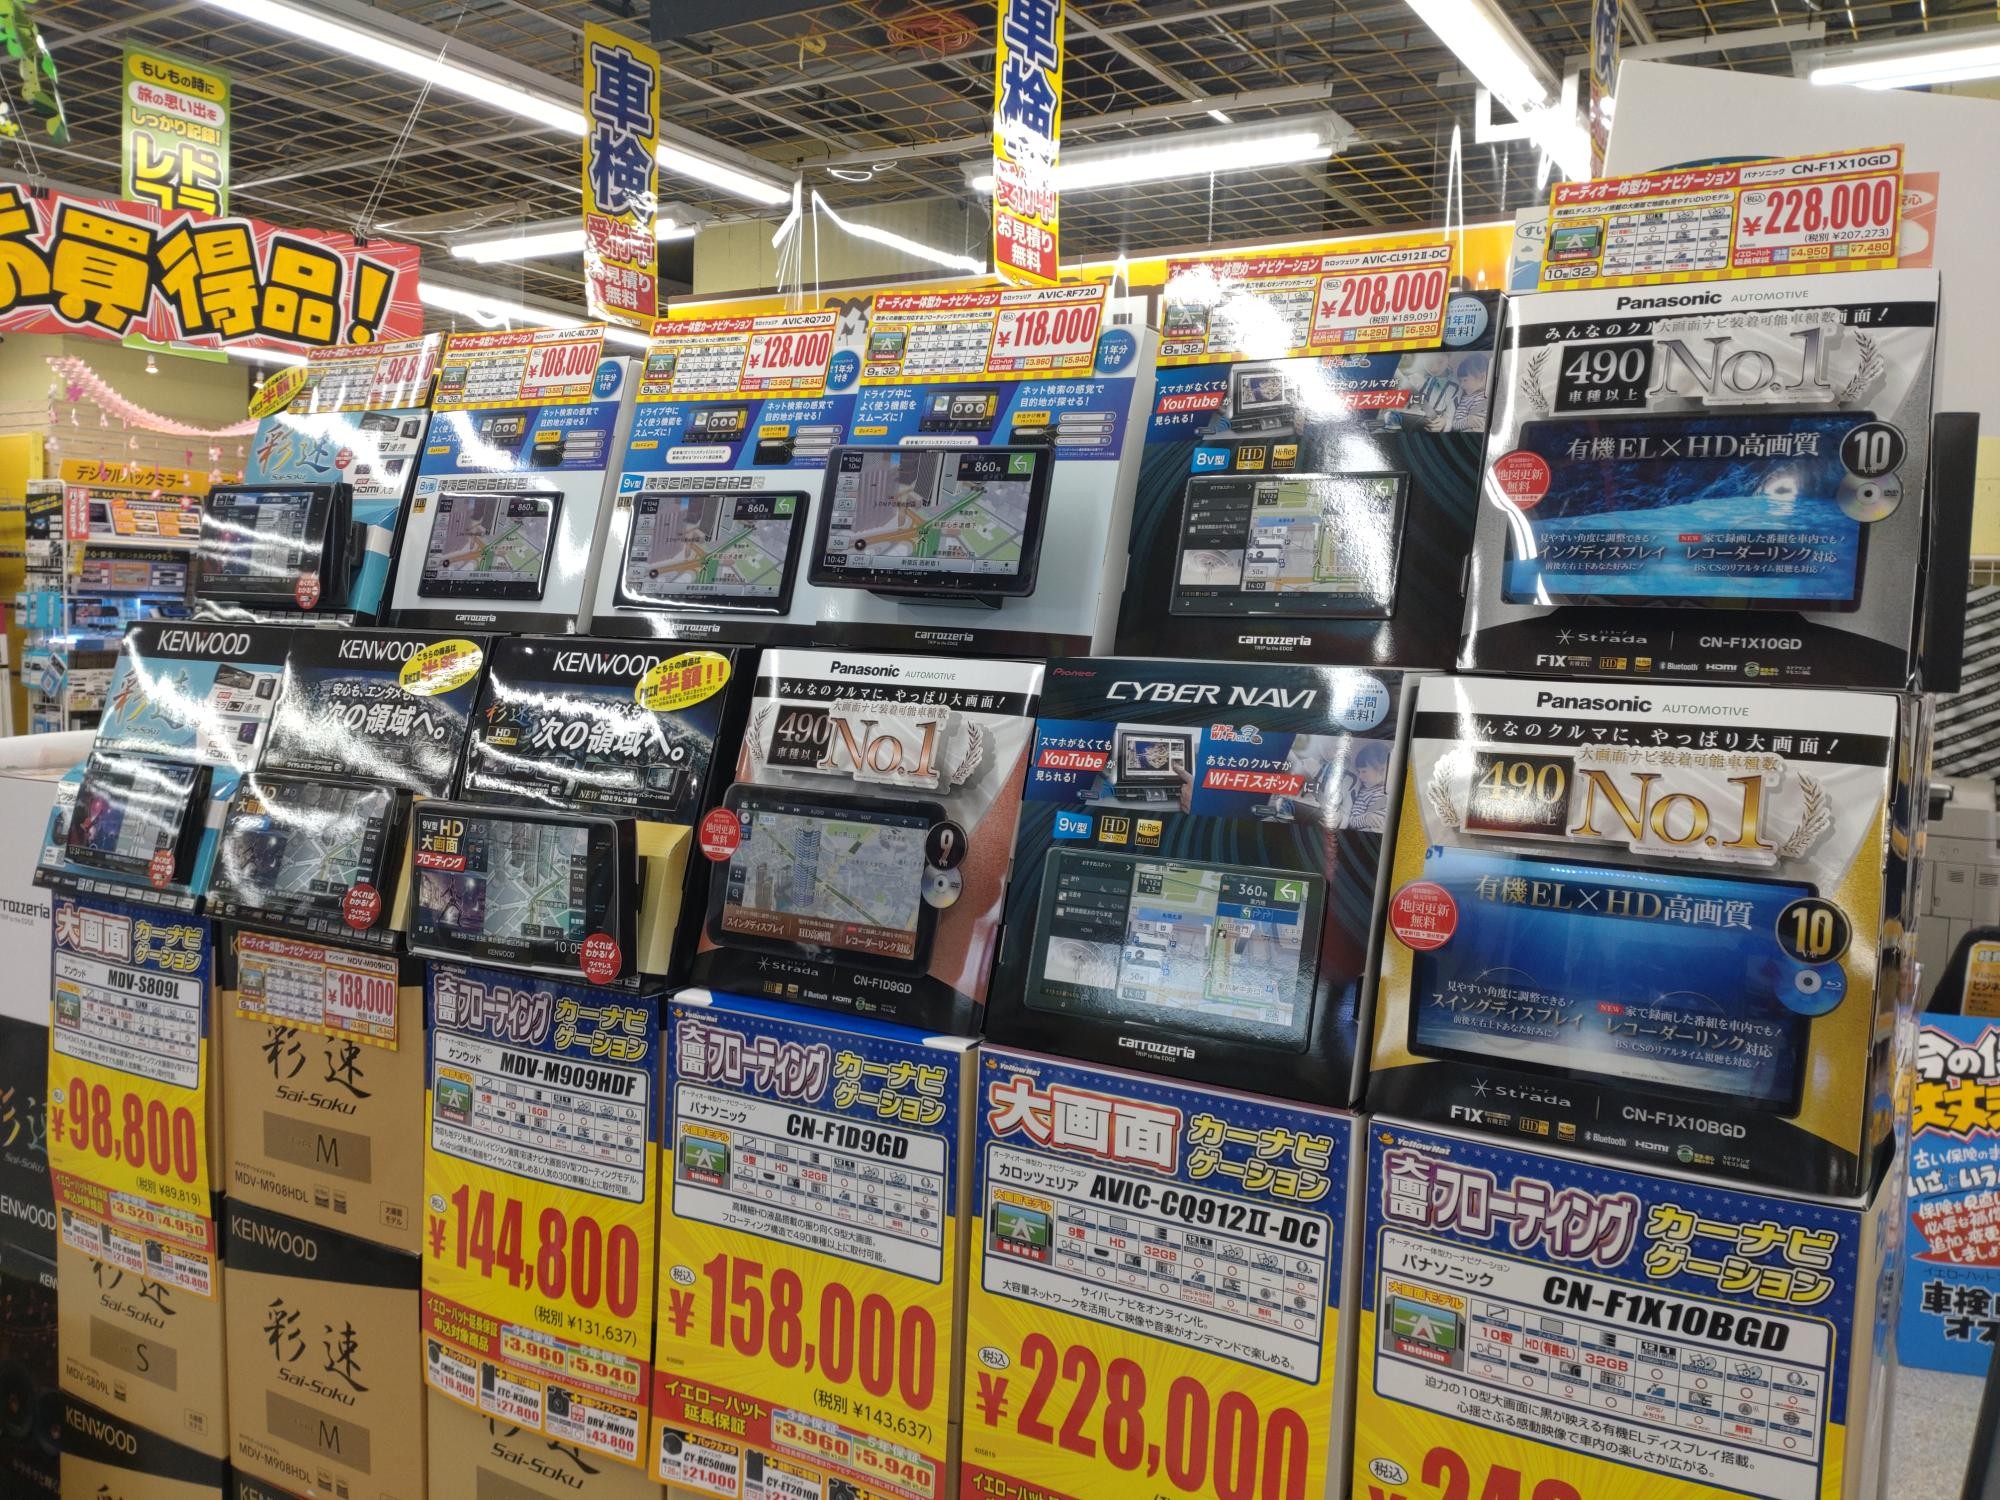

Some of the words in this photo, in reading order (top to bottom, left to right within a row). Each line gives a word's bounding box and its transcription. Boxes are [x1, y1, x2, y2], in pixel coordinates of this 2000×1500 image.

[140, 61, 215, 94] もしもの時に
[138, 86, 217, 121] 旅の思い出を
[131, 106, 222, 146] しっかり記録!
[589, 43, 655, 222] 車検
[1557, 170, 1737, 201] オーディオ一体型カーナビゲーション
[1792, 154, 1892, 175] CN-F1X10GD
[1741, 179, 1892, 237] ¥228,000
[997, 215, 1055, 253] お見積り
[1804, 232, 1829, 244] (税別
[1832, 227, 1889, 242] ¥207,273)
[1011, 243, 1042, 272] 無料
[876, 293, 999, 310] オーディオ一体型カーナビゲーション
[1037, 287, 1097, 300] AVIC-RF720
[1320, 269, 1445, 320] ¥208,000
[1616, 290, 1723, 311] Panasonic
[1730, 289, 1810, 304] AUTOMOTIVE
[558, 328, 600, 340] AVIC-RL720
[782, 315, 832, 327] AVIC-RQ720
[997, 306, 1097, 348] ¥118,000
[528, 350, 598, 380] ¥108,000
[748, 332, 828, 370] ¥128,000
[1565, 346, 1645, 385] 490
[1648, 327, 1836, 396] No.1
[863, 388, 913, 399] ドライブ中に
[1020, 396, 1090, 408] 目的地が探せる!
[1022, 385, 1105, 396] ネット検索の感覚で
[1159, 381, 1229, 395] スマホがなくても
[1162, 394, 1220, 411] YouTube
[542, 407, 600, 418] ネット検索の感覚で
[639, 407, 679, 417] ドライブ中に
[767, 400, 834, 410] ネット検索の感覚で
[857, 410, 904, 423] スムーズに!
[859, 400, 917, 411] よく使う機能を
[1155, 412, 1195, 427] 見られる!
[633, 426, 672, 438] スムーズに!
[1238, 446, 1264, 461] HD
[1853, 430, 1889, 469] 10
[1685, 543, 1838, 564] レコーダーリンク対応
[157, 629, 251, 655] KENWOOD
[914, 629, 975, 642] carrozzeria
[1238, 634, 1312, 647] carrozzeria
[1577, 632, 1648, 645] Strada
[1699, 635, 1803, 651] CN-F1X10GD
[654, 655, 702, 675] こちらの商品は
[829, 660, 901, 679] Panasonic
[904, 670, 958, 682] AUTOMOTIVE
[1052, 667, 1098, 678] Pioneer
[1536, 653, 1567, 668] F1X
[1666, 662, 1700, 672] Bluetooth
[779, 681, 1008, 711] みんなのクルマに、やっぱり大画面!
[1105, 680, 1221, 706] CYBER
[1226, 686, 1319, 710] NAVI
[1536, 691, 1653, 714] Panasonic
[1661, 703, 1751, 718] AUTOMOTIVE
[494, 726, 511, 738] HD
[777, 710, 829, 744] 490
[1472, 720, 1840, 757] んなのクルマに、やっぱり大画面!
[819, 718, 941, 778] No.1
[1039, 736, 1113, 752] スマホがなくても
[1042, 750, 1104, 769] YouTube
[1034, 769, 1077, 784] 見られる!
[1205, 755, 1293, 771] あなたのクルマが
[1477, 760, 1567, 804] 490
[1102, 817, 1128, 834] HD
[1569, 768, 1775, 852] No.1
[439, 817, 464, 837] HD
[1137, 836, 1159, 846] AUDIO
[1138, 822, 1162, 834] Hi-Res
[420, 834, 459, 854] 大画面
[415, 852, 464, 871] フローティング
[1399, 898, 1451, 918] 地図更新
[1473, 873, 1755, 931] 有機EL×HD高画質
[56, 904, 132, 962] 大画面
[135, 920, 204, 950] カーナビ
[1410, 913, 1437, 930] 無料
[1791, 906, 1834, 953] 10
[135, 942, 201, 972] ゲーション
[586, 939, 614, 951] めくれば
[107, 969, 180, 1000] MDV-S809L
[772, 961, 819, 977] Strada
[853, 974, 913, 995] CN-F1D9GD
[1446, 979, 1575, 1009] 見やすい角度に調整できる!
[328, 972, 395, 1018] ¥138,000
[1431, 991, 1585, 1028] スイングディスプレイ
[457, 984, 550, 1043] フローティング
[555, 998, 648, 1034] カーナビ
[1624, 1004, 1783, 1038] 家で録画した番組を車内でも!
[555, 1025, 647, 1061] ゲーション
[1117, 1035, 1197, 1060] carrozzeria
[1606, 1016, 1775, 1060] レコーダーリンク対応
[447, 1048, 482, 1066] ケンウッド
[708, 1032, 829, 1102] フローティング
[835, 1052, 946, 1095] カーナビ
[998, 1060, 1042, 1078] YellowHat
[500, 1052, 638, 1097] MDV-M909HDF
[275, 1084, 360, 1117] Sai-Soku
[689, 1100, 748, 1124] パナソニック
[835, 1081, 945, 1124] ゲーション
[1494, 1085, 1573, 1109] Strada
[1621, 1105, 1748, 1141] CN-F1X10BGD
[51, 1076, 199, 1185] ¥98,800
[785, 1112, 910, 1162] CN-F1D9GD
[990, 1077, 1179, 1169] 大画面
[1450, 1104, 1484, 1123] F1X
[1592, 1131, 1628, 1148] Bluetooth
[316, 1133, 340, 1168] M
[1190, 1114, 1333, 1167] カーナビ
[1396, 1136, 1451, 1157] YellowHat
[774, 1162, 789, 1174] HD
[800, 1168, 829, 1184] 32GB
[998, 1161, 1080, 1192] カロッツェリア
[1189, 1147, 1331, 1201] ゲーション
[159, 1183, 202, 1208] ¥89,819)
[234, 1169, 310, 1204] MDV-M908HDL
[992, 1188, 1053, 1213] 大画面モデル
[1389, 1155, 1432, 1222] 大画面
[730, 1201, 878, 1248] 高精細HD液晶搭載の振り向く9型大画面。
[1432, 1165, 1634, 1264] フローティング
[230, 1213, 319, 1263] KENWOOD
[721, 1211, 889, 1264] フローティング構造で490車種以上に取付可能。
[1067, 1226, 1086, 1241] 9型
[1109, 1236, 1127, 1250] HD
[1646, 1203, 1838, 1268] カーナビ
[428, 1182, 640, 1320] ¥144,800
[1143, 1245, 1178, 1264] 32GB
[1387, 1236, 1511, 1273] オーディオ一体型カーナビゲーション
[671, 1268, 693, 1283] 税込
[1400, 1253, 1496, 1289] パナソニック
[1646, 1242, 1834, 1305] ゲーション
[1079, 1285, 1211, 1332] サイバーナビをオンライン化。
[1387, 1280, 1467, 1311] 大画面モデル
[99, 1293, 166, 1332] Sai-Soku
[533, 1304, 564, 1329] (税別
[566, 1313, 638, 1348] ¥131,637)
[1001, 1278, 1298, 1373] 大容量ネットワークを活用して映像や音楽がオンデマンドで楽しめる。
[1542, 1275, 1791, 1354] CN-F1X10BGD
[263, 1296, 370, 1393] 彩速
[433, 1316, 490, 1352] 申込対象商品
[667, 1251, 937, 1412] ¥158,000
[1481, 1326, 1514, 1347] 10型
[135, 1343, 150, 1373] S
[981, 1348, 1008, 1367] 税込
[1584, 1351, 1630, 1373] 32GB
[276, 1366, 356, 1408] Sai-Soku
[665, 1380, 768, 1421] イエローハット
[64, 1404, 138, 1456] KENWOOD
[683, 1402, 747, 1437] 延長保証
[813, 1387, 848, 1416] (税別
[852, 1401, 934, 1446] ¥143,637)
[975, 1330, 1311, 1500] ¥228,000
[1424, 1374, 1758, 1473] 迫力の10型大画面に黒が映える有機ELディスプレイ搭載。
[317, 1419, 342, 1455] M
[1455, 1401, 1718, 1480] 心揺さぶる感動映像で車内の楽しさが広がる。
[238, 1440, 313, 1485] MDV-M908HDL
[490, 1442, 585, 1491] Sai-Soku
[1373, 1461, 1405, 1486] 税込
